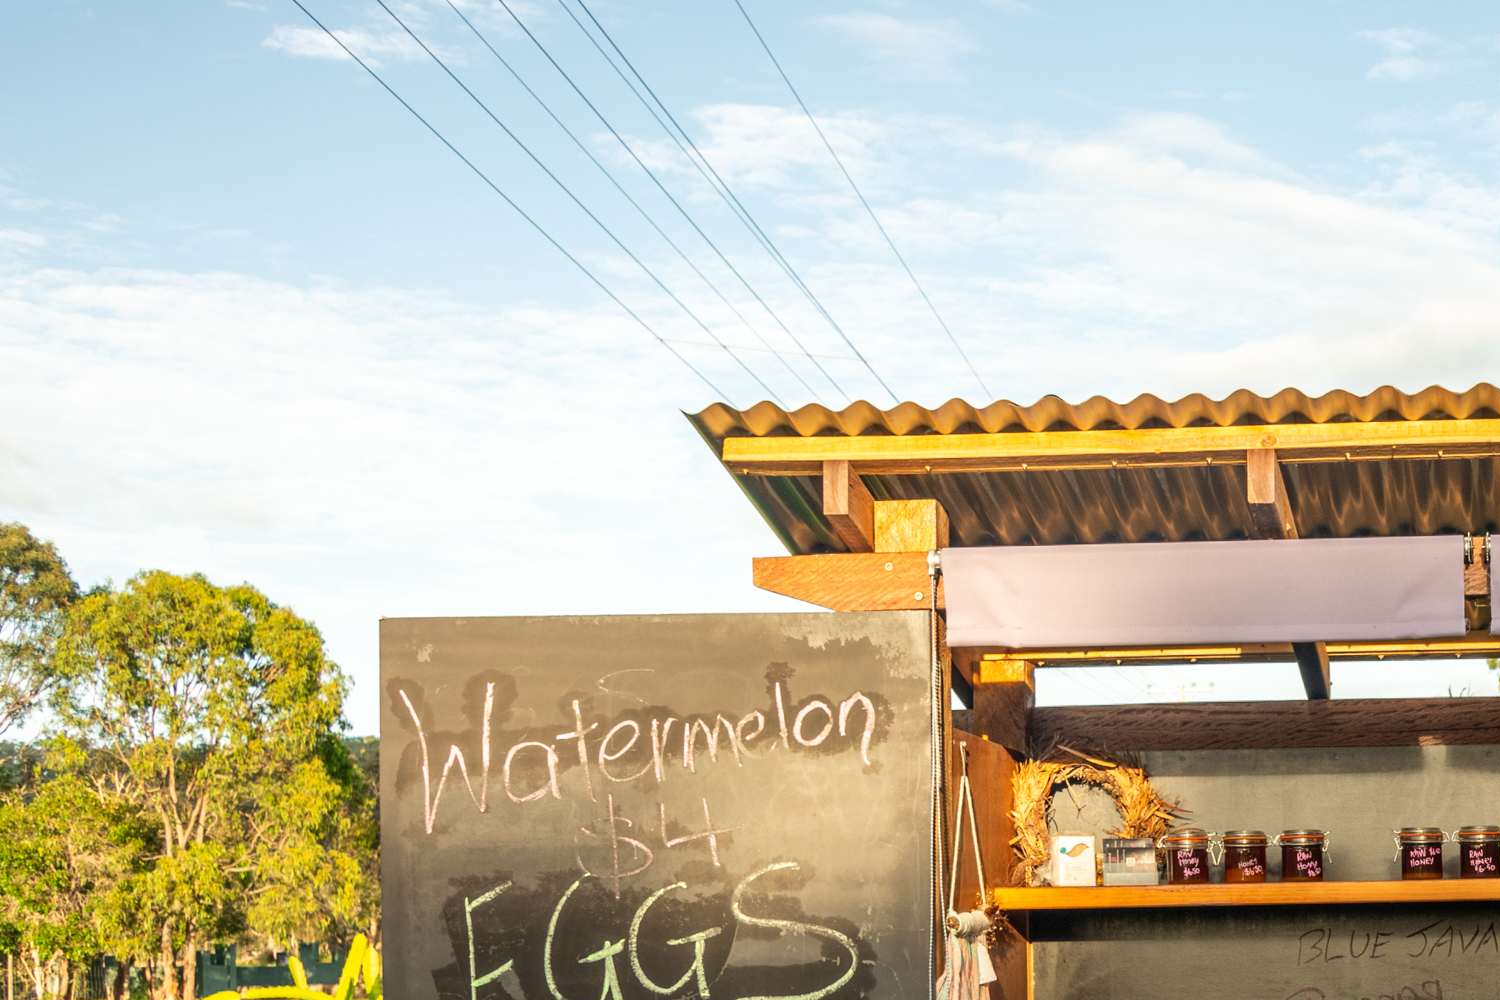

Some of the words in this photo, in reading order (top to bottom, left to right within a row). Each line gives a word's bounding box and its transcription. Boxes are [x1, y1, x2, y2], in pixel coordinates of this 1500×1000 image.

[399, 682, 873, 834] Watermelon
[573, 794, 744, 900] $4
[1297, 928, 1395, 967] BLUE
[1406, 919, 1499, 958] JAVA
